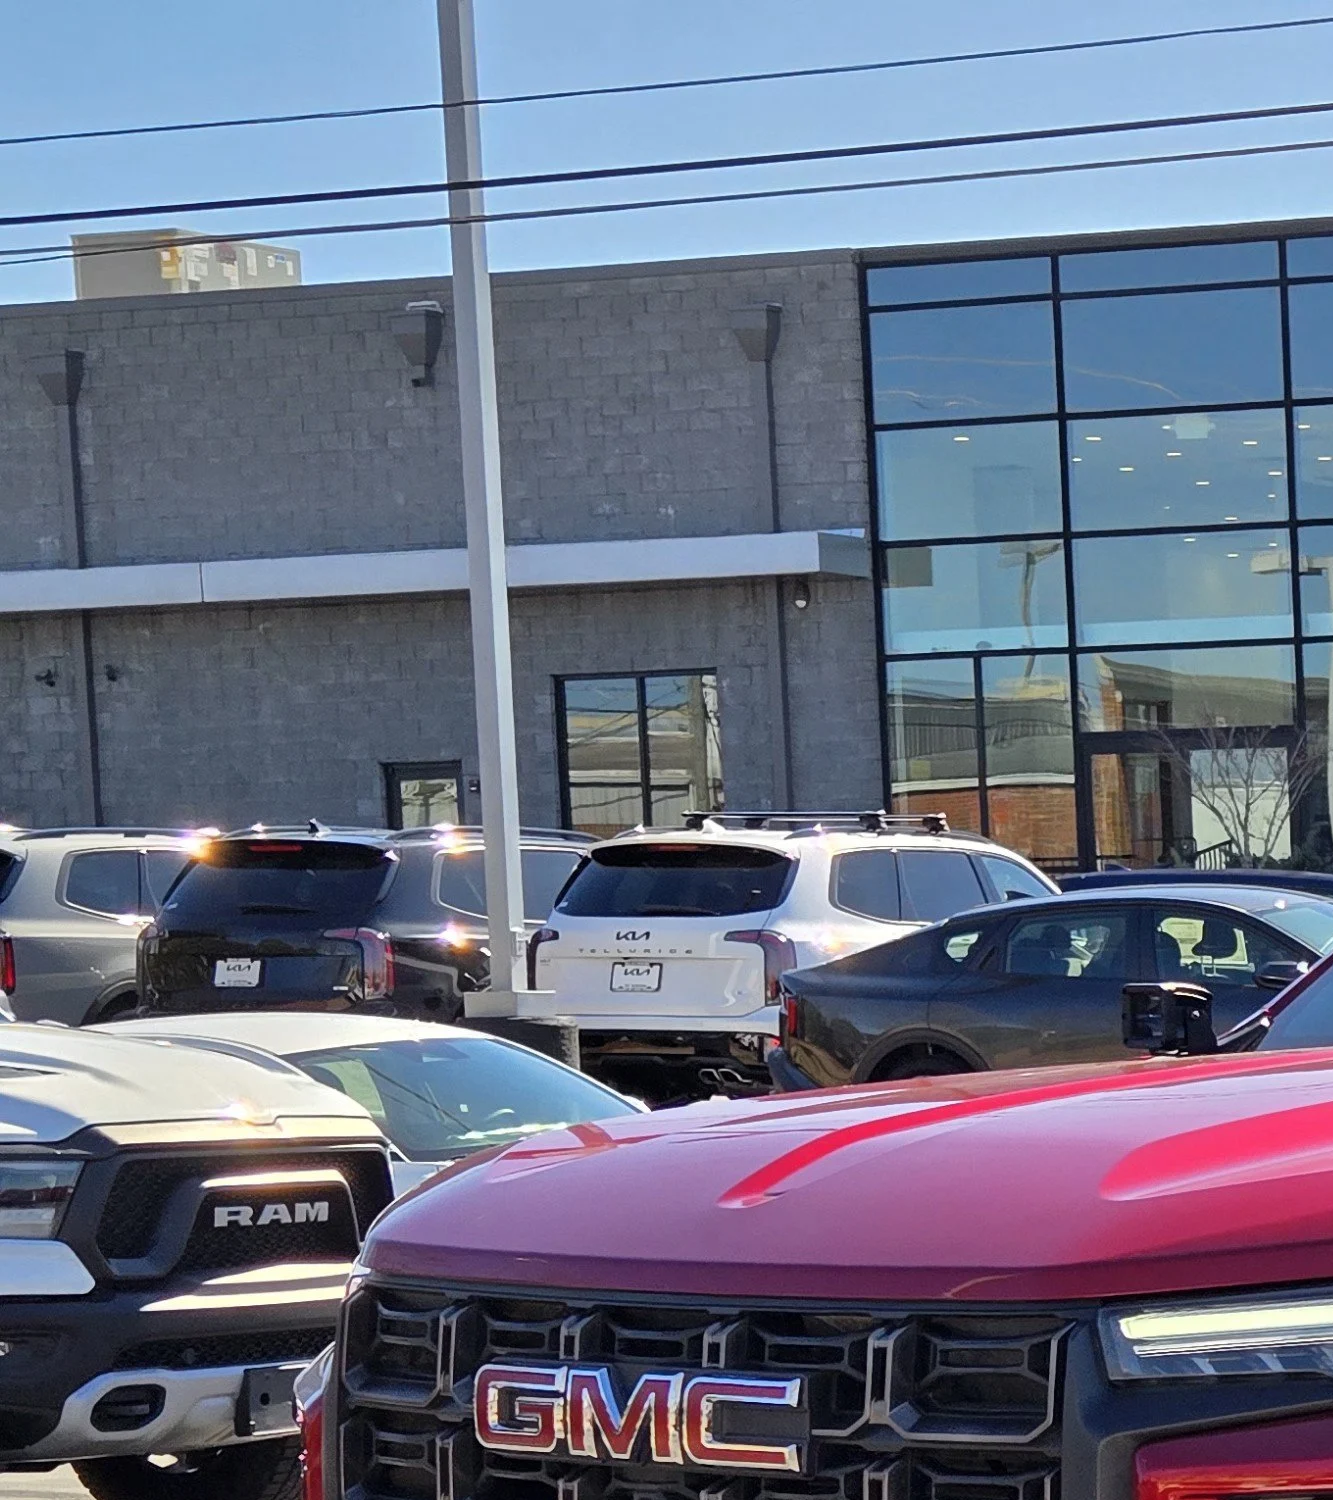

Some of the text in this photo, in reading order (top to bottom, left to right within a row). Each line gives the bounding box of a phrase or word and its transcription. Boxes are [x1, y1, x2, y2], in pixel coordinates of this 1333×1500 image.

[616, 931, 651, 941] KIA
[226, 964, 252, 972] KIA
[624, 968, 651, 976] KIA
[213, 1201, 330, 1228] RAM
[473, 1364, 802, 1472] GMC
